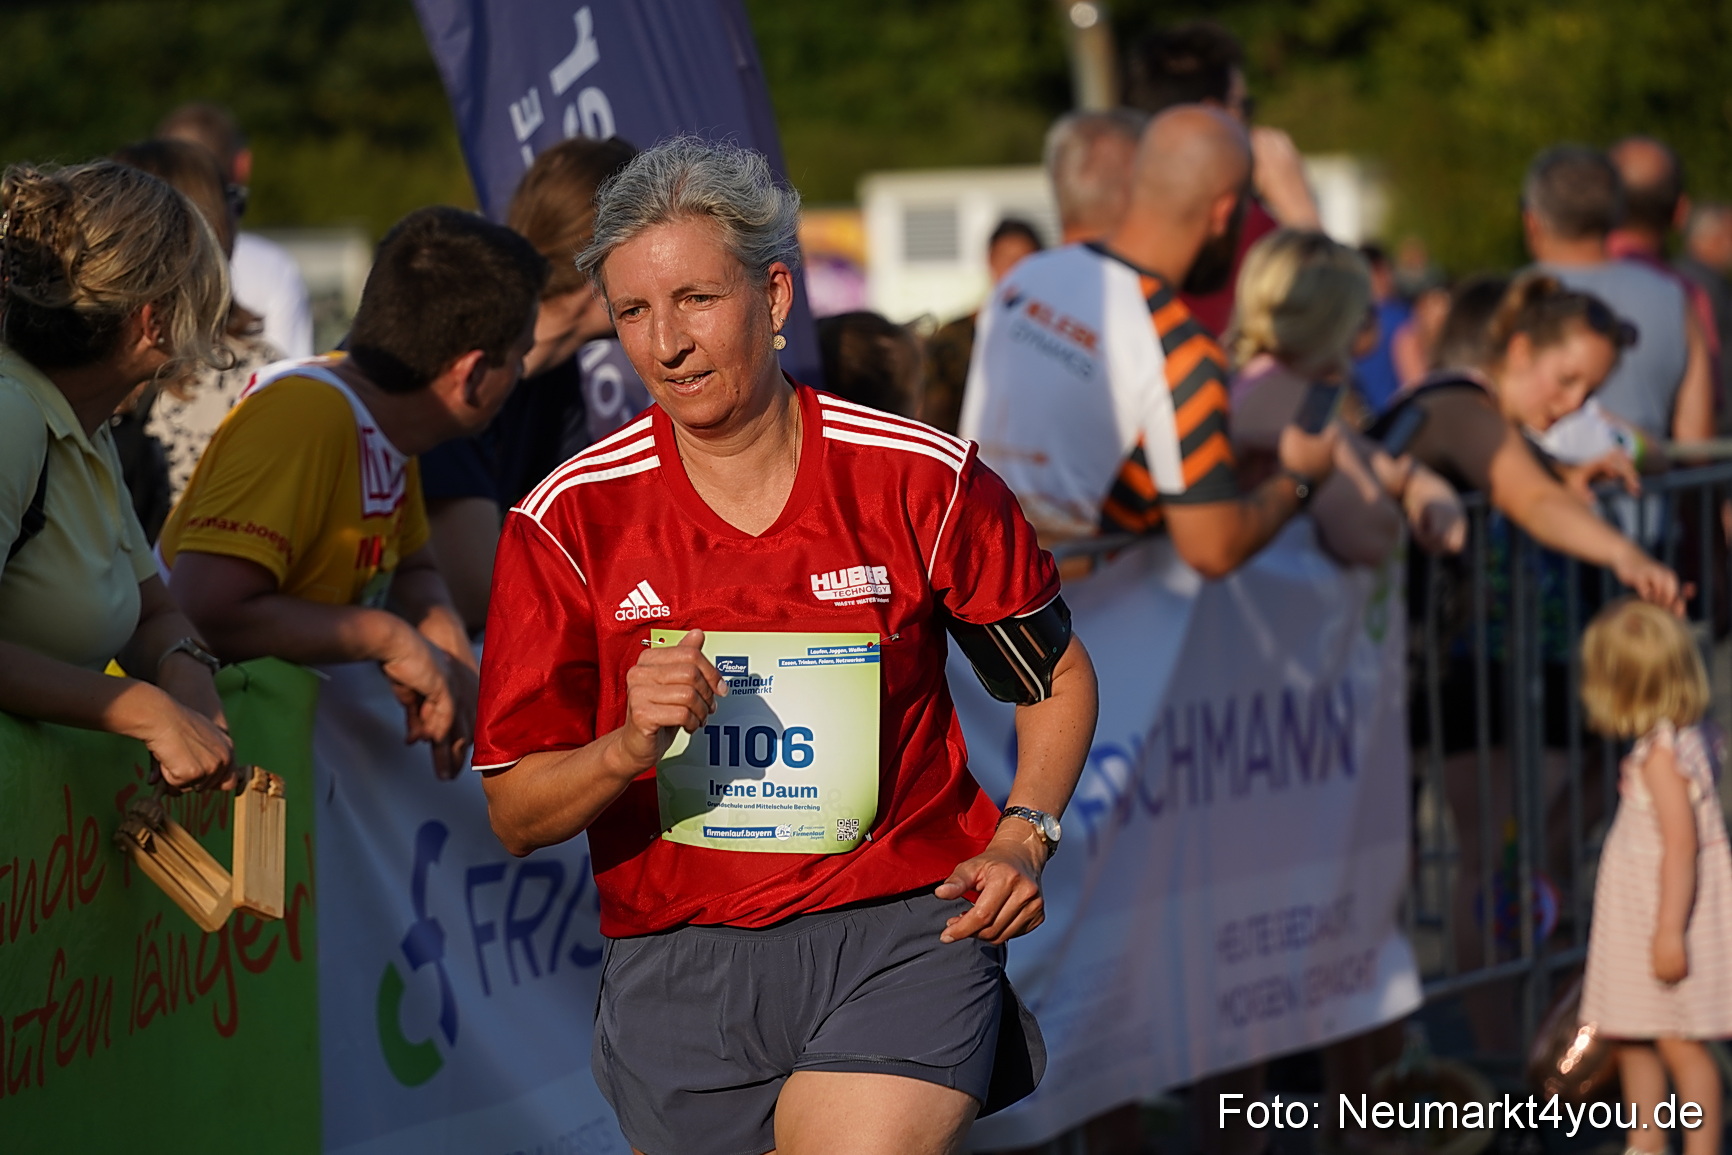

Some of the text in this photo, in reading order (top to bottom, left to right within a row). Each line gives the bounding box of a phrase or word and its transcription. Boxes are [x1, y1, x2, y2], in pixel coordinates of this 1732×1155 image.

[810, 565, 890, 591] HUBER
[832, 585, 888, 598] TECHNOGY
[615, 604, 671, 621] adidas
[725, 675, 774, 688] menlauf
[731, 686, 773, 695] neumarkt
[704, 725, 815, 768] 1106
[709, 779, 818, 799] Irene Daum
[707, 801, 743, 809] Grundschule
[793, 804, 821, 812] Berching
[706, 828, 773, 839] firmenlauf.bayern
[0, 947, 114, 1099] ufen
